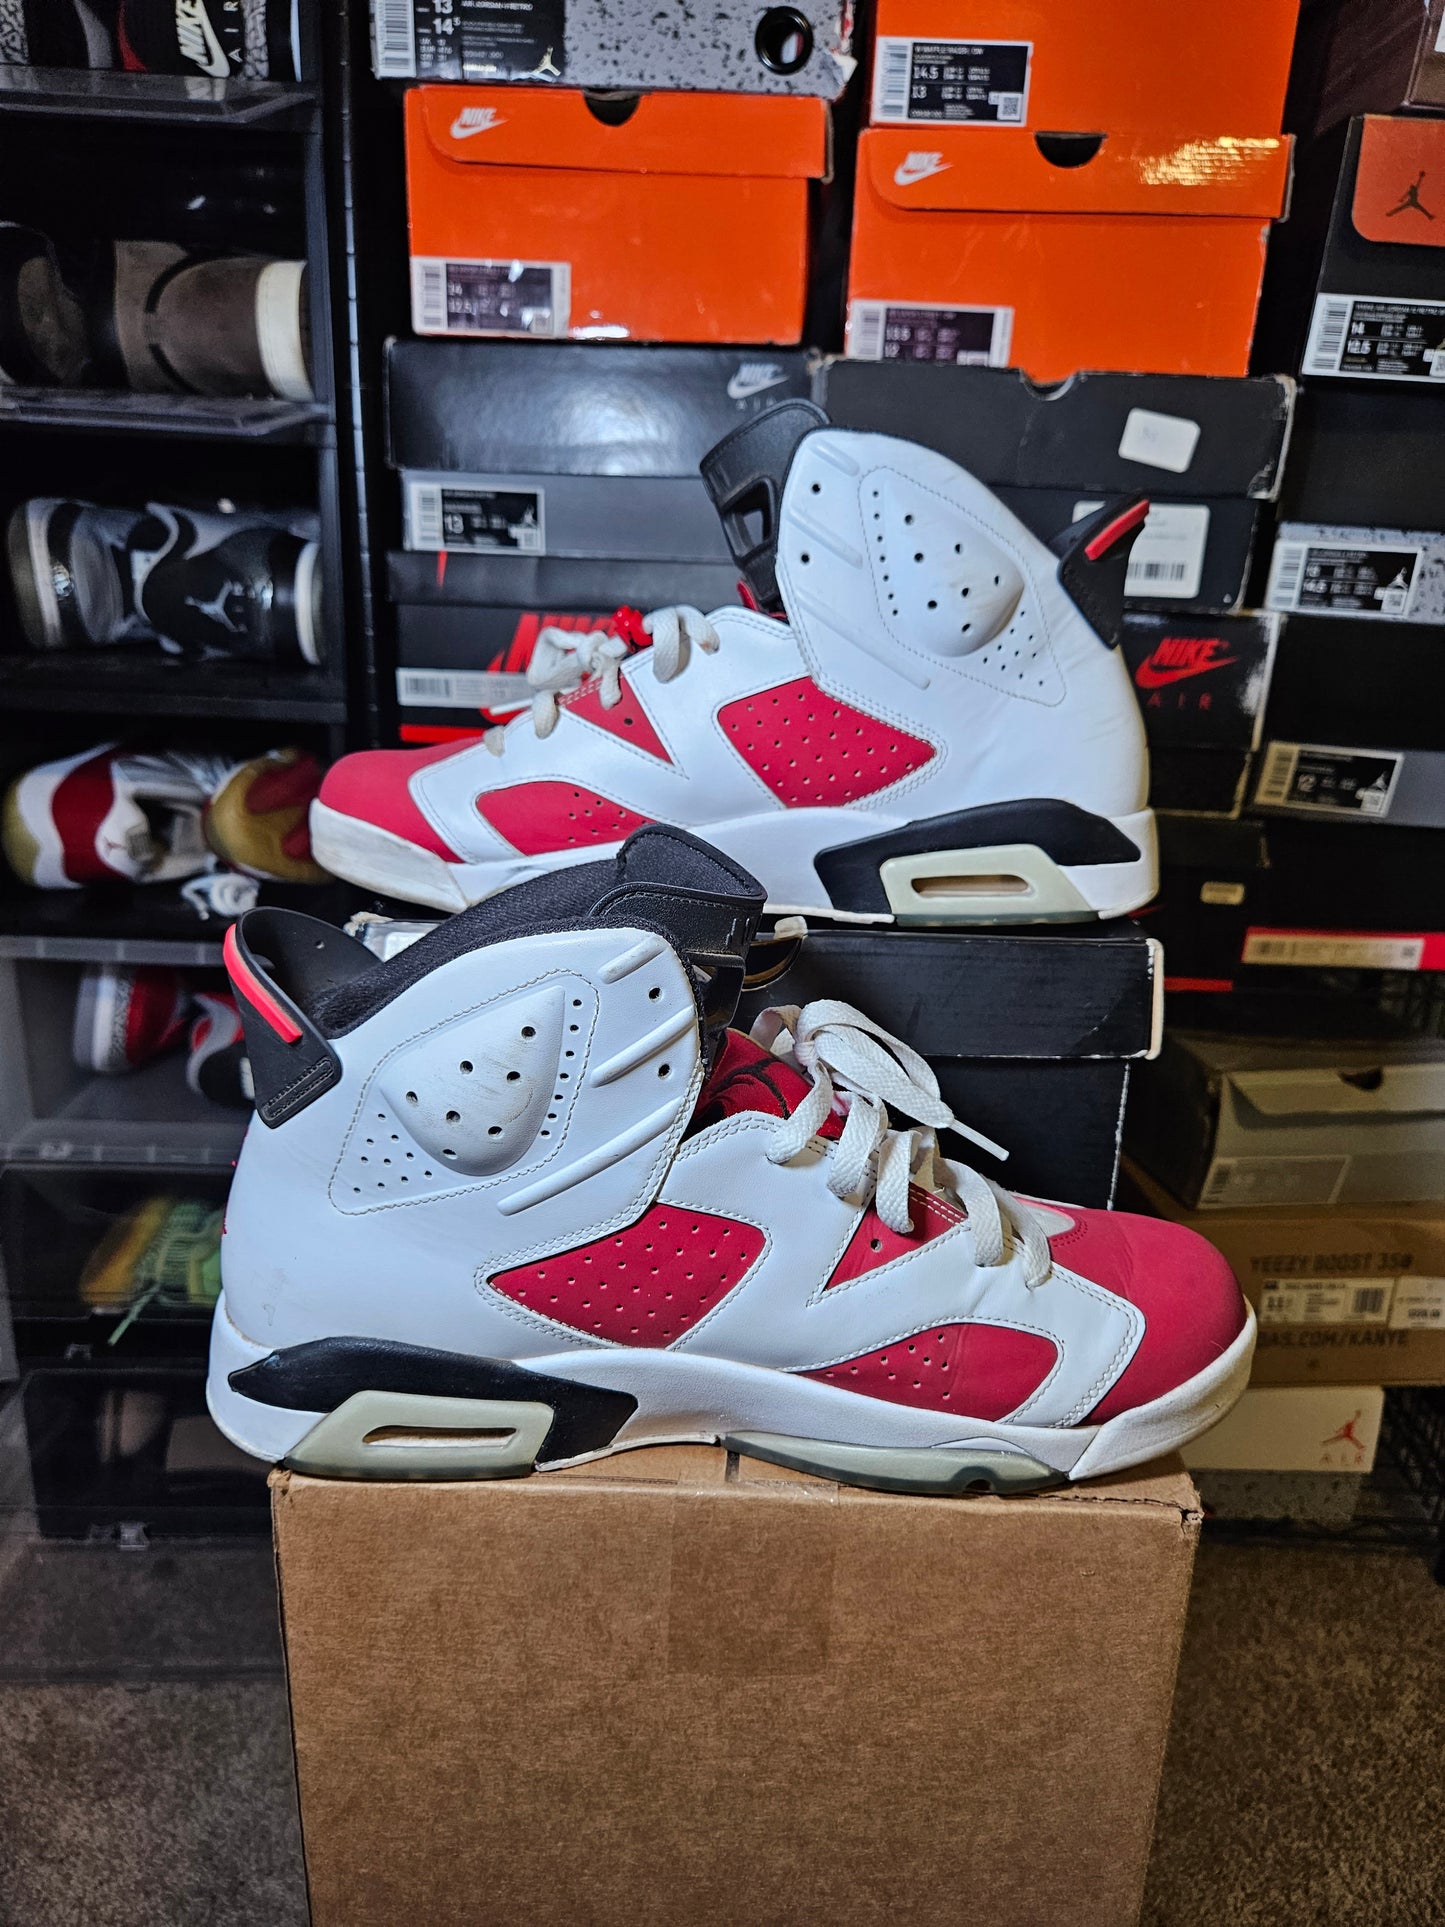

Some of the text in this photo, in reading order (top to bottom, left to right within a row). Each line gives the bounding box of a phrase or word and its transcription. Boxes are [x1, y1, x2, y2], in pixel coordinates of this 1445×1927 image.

[1147, 691, 1212, 711] AIR
[1250, 1254, 1308, 1274] YEEZY
[1312, 1252, 1373, 1272] BOOST
